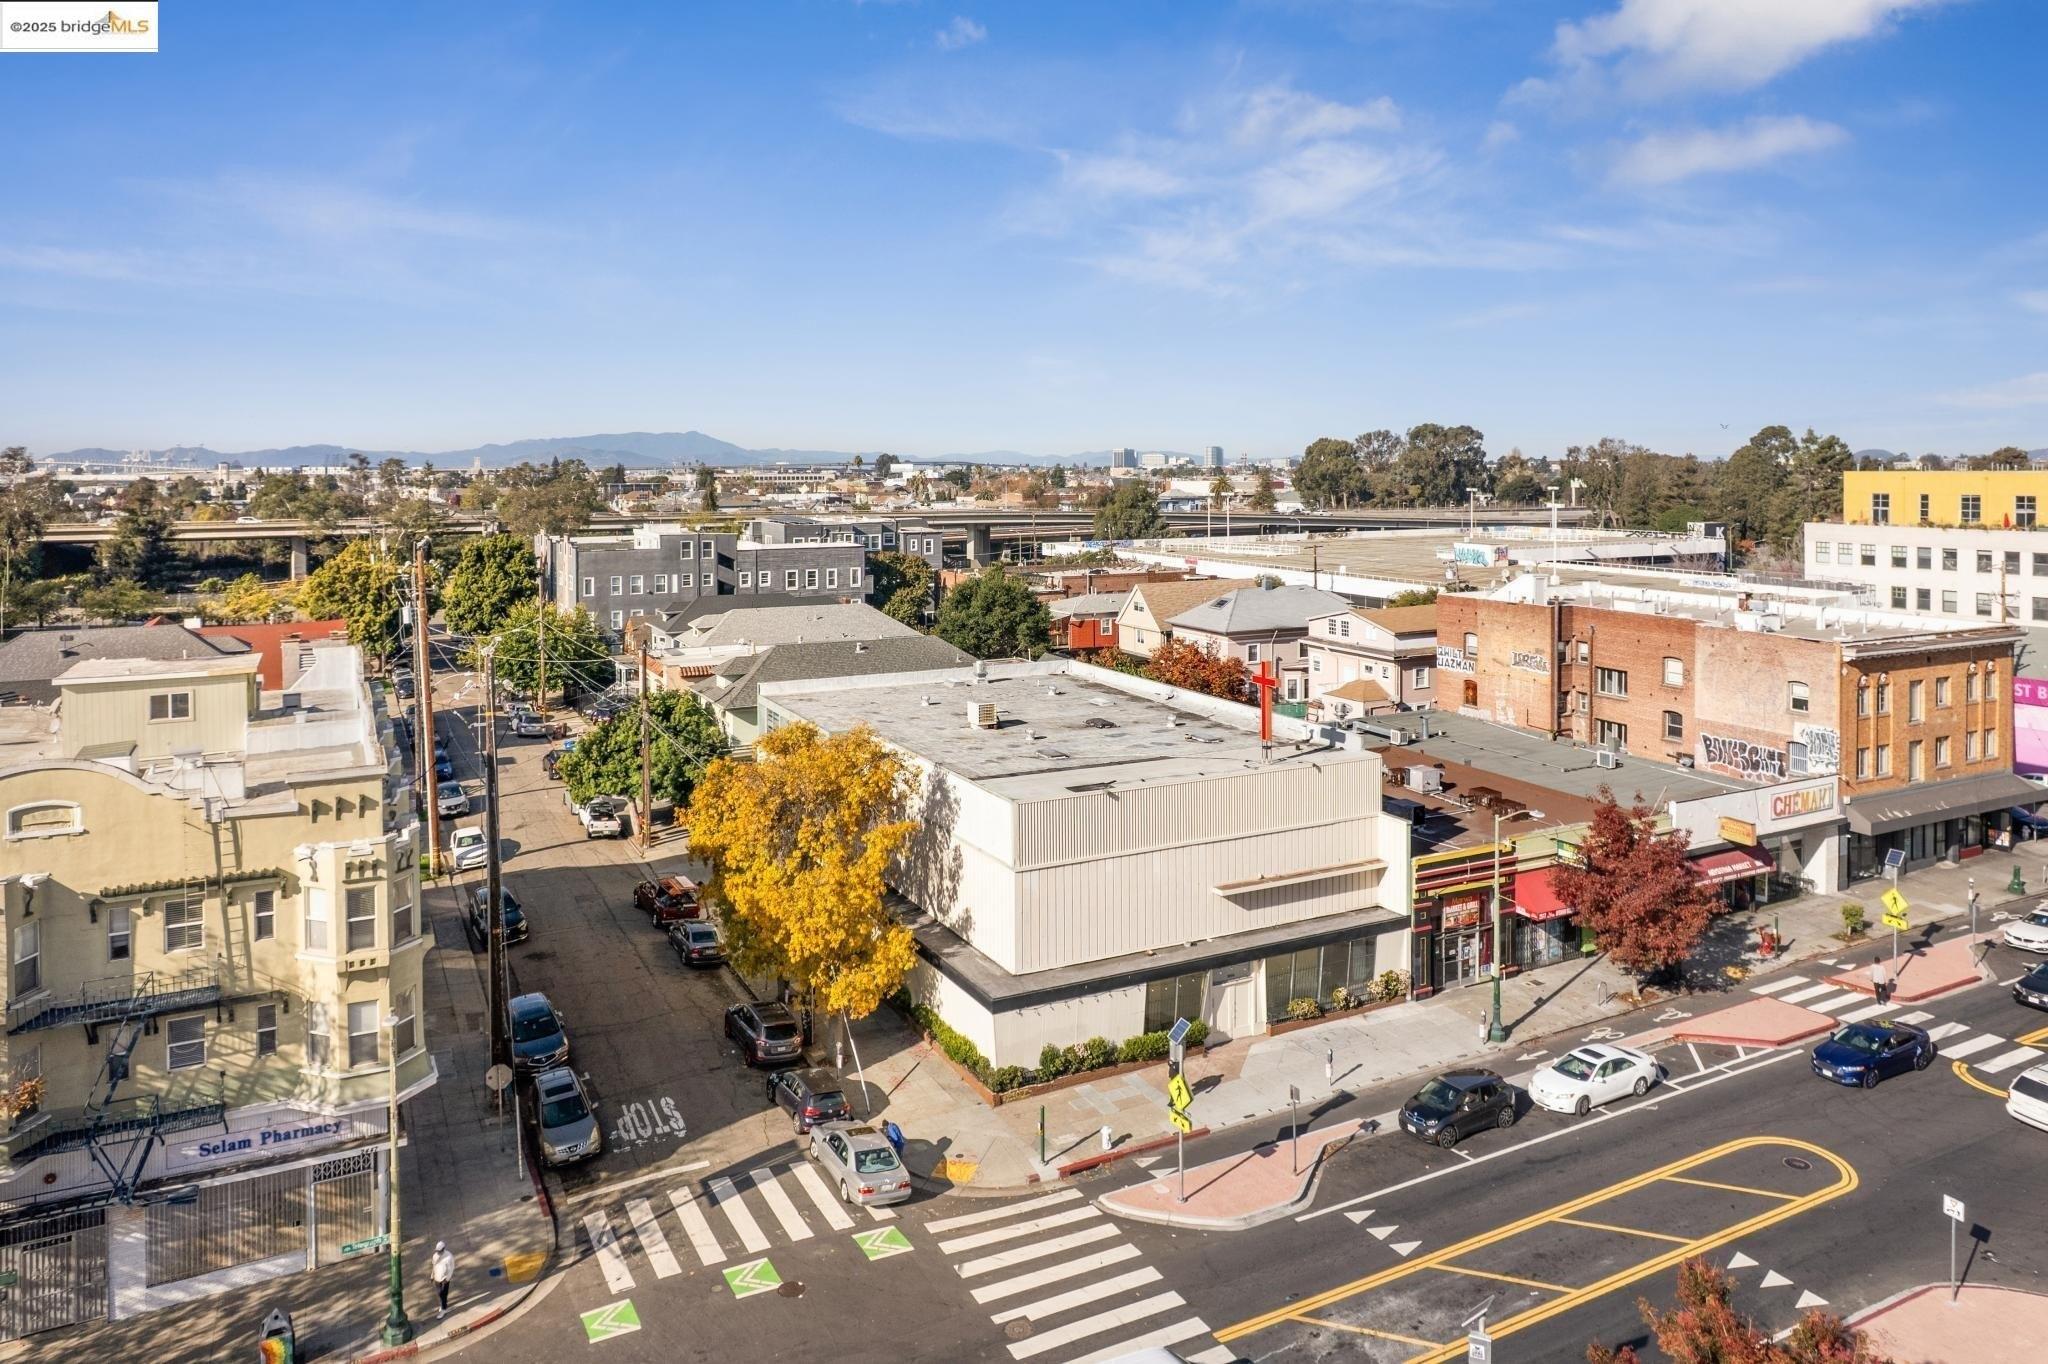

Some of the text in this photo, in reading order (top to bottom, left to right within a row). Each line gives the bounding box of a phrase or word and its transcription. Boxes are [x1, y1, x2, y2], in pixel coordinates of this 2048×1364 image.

[199, 1120, 342, 1157] Selam Pharmacy
[616, 1096, 687, 1141] STOP
